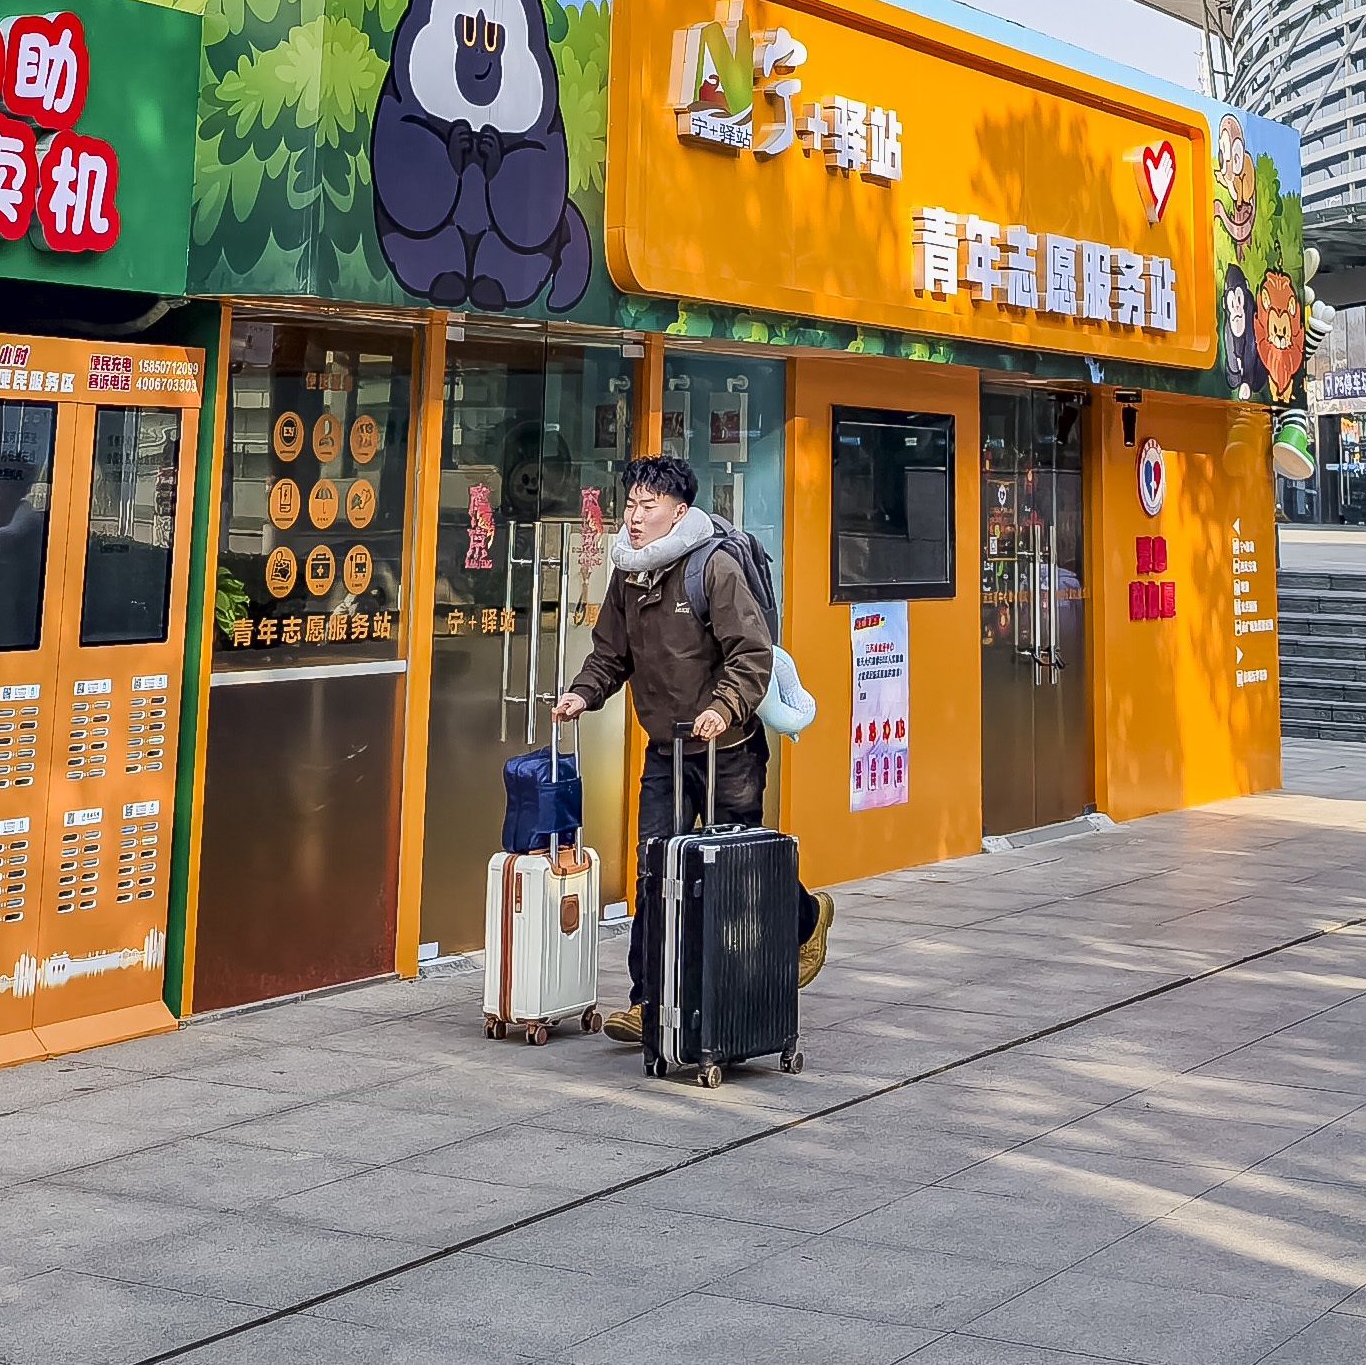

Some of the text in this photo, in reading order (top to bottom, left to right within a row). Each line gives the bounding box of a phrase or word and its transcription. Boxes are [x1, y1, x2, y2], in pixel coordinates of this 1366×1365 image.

[691, 116, 752, 150] 宁+驿站
[919, 207, 1177, 332] 青年志愿服务站
[89, 354, 133, 374] 便民充电
[87, 373, 131, 391] 客诉电话
[233, 611, 392, 647] 青年志愿服务站
[448, 608, 517, 634] 宁+驿站
